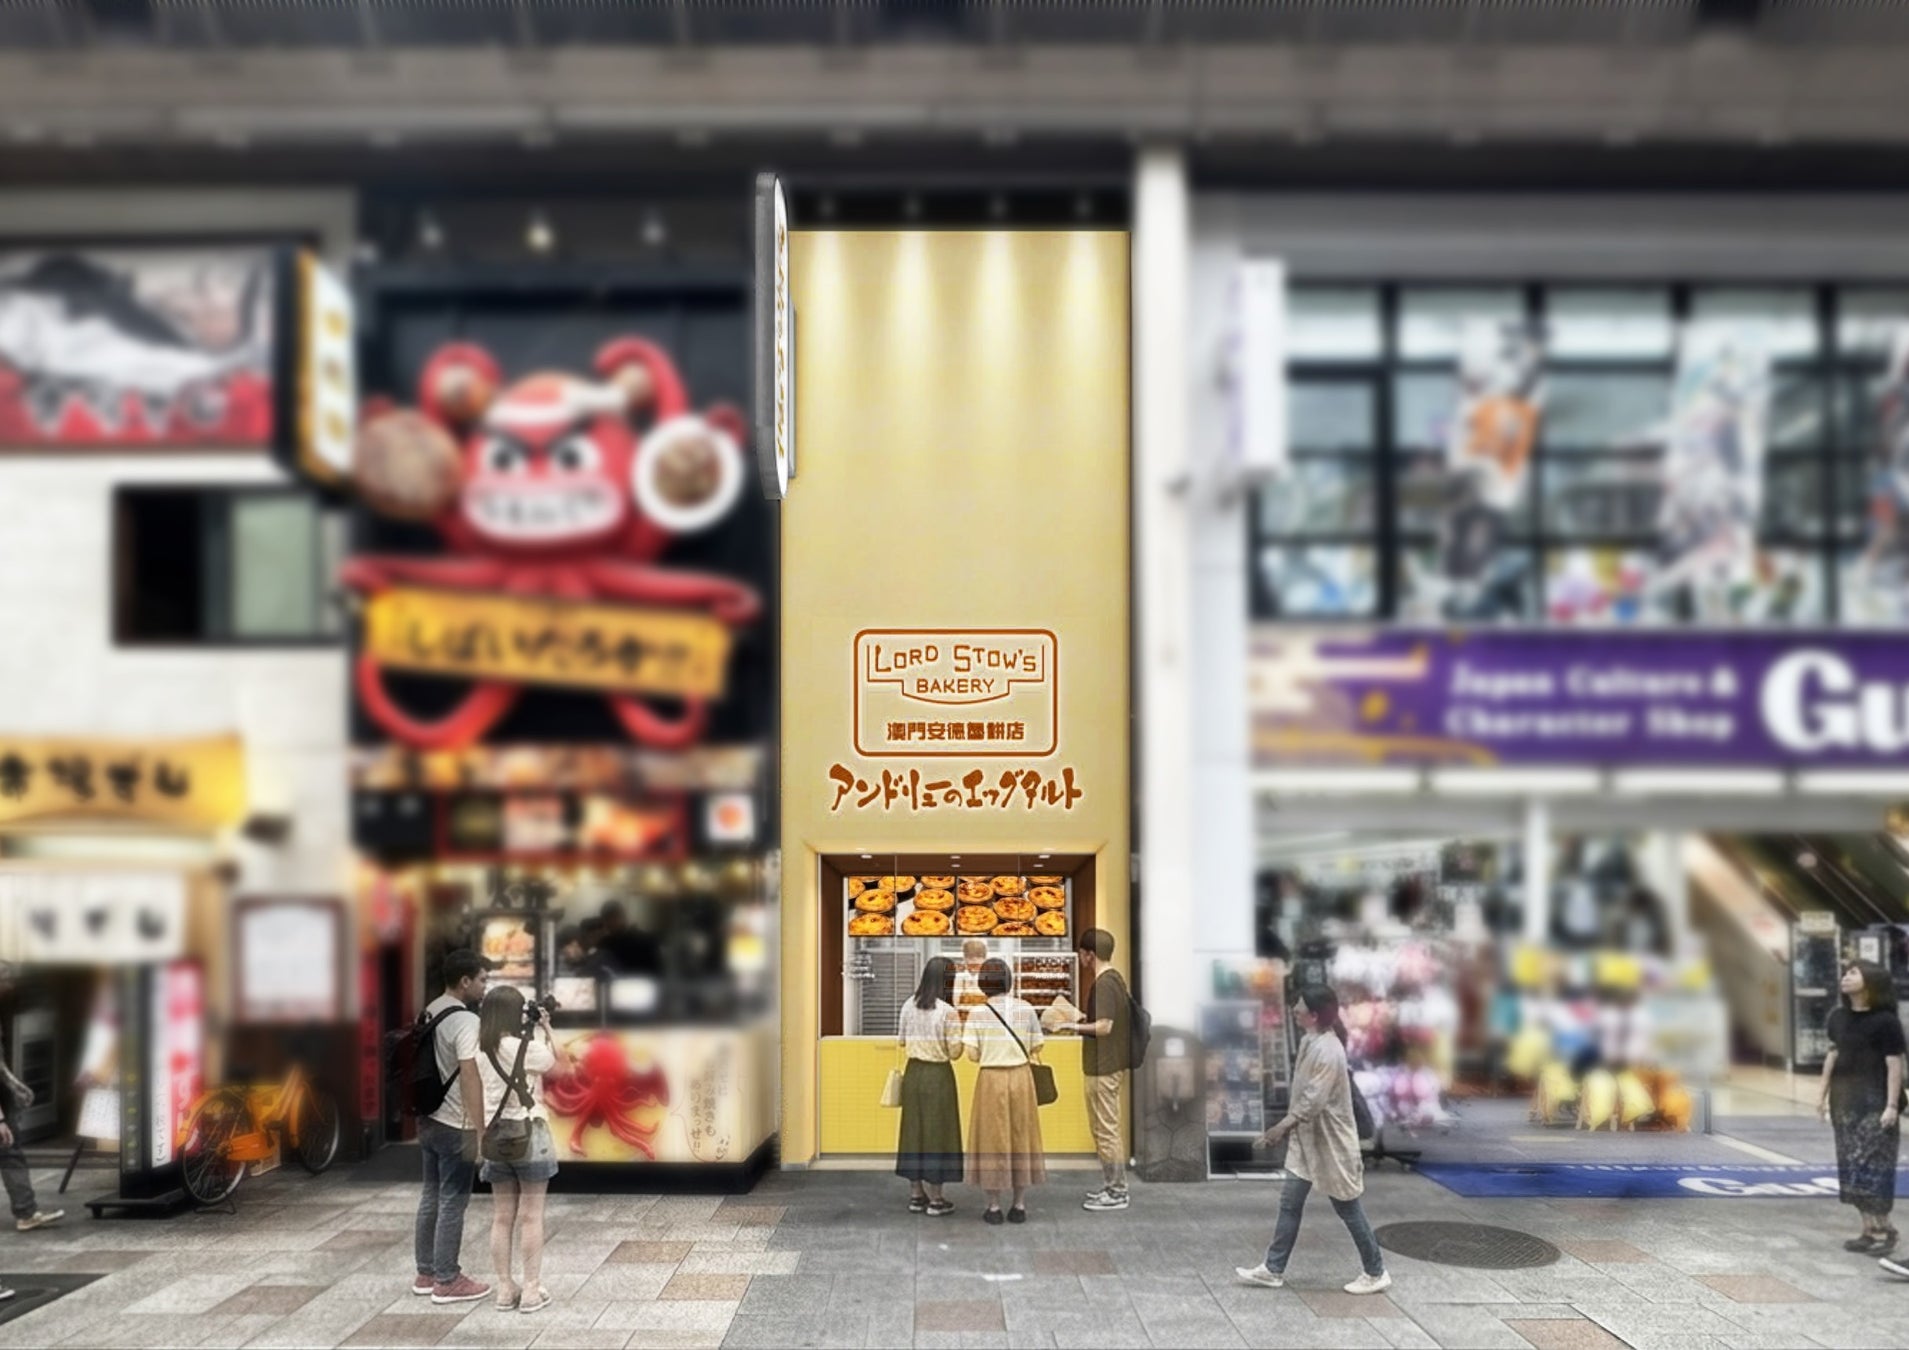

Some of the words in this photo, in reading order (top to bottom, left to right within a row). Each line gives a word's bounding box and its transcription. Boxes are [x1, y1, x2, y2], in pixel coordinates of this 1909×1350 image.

[916, 678, 995, 693] BAKERY
[1451, 661, 1554, 701] Japan
[1566, 663, 1703, 697] Culture
[1445, 704, 1632, 738] Character
[1645, 704, 1736, 740] Shop
[829, 763, 1082, 810] アンドリューのエッグタルト
